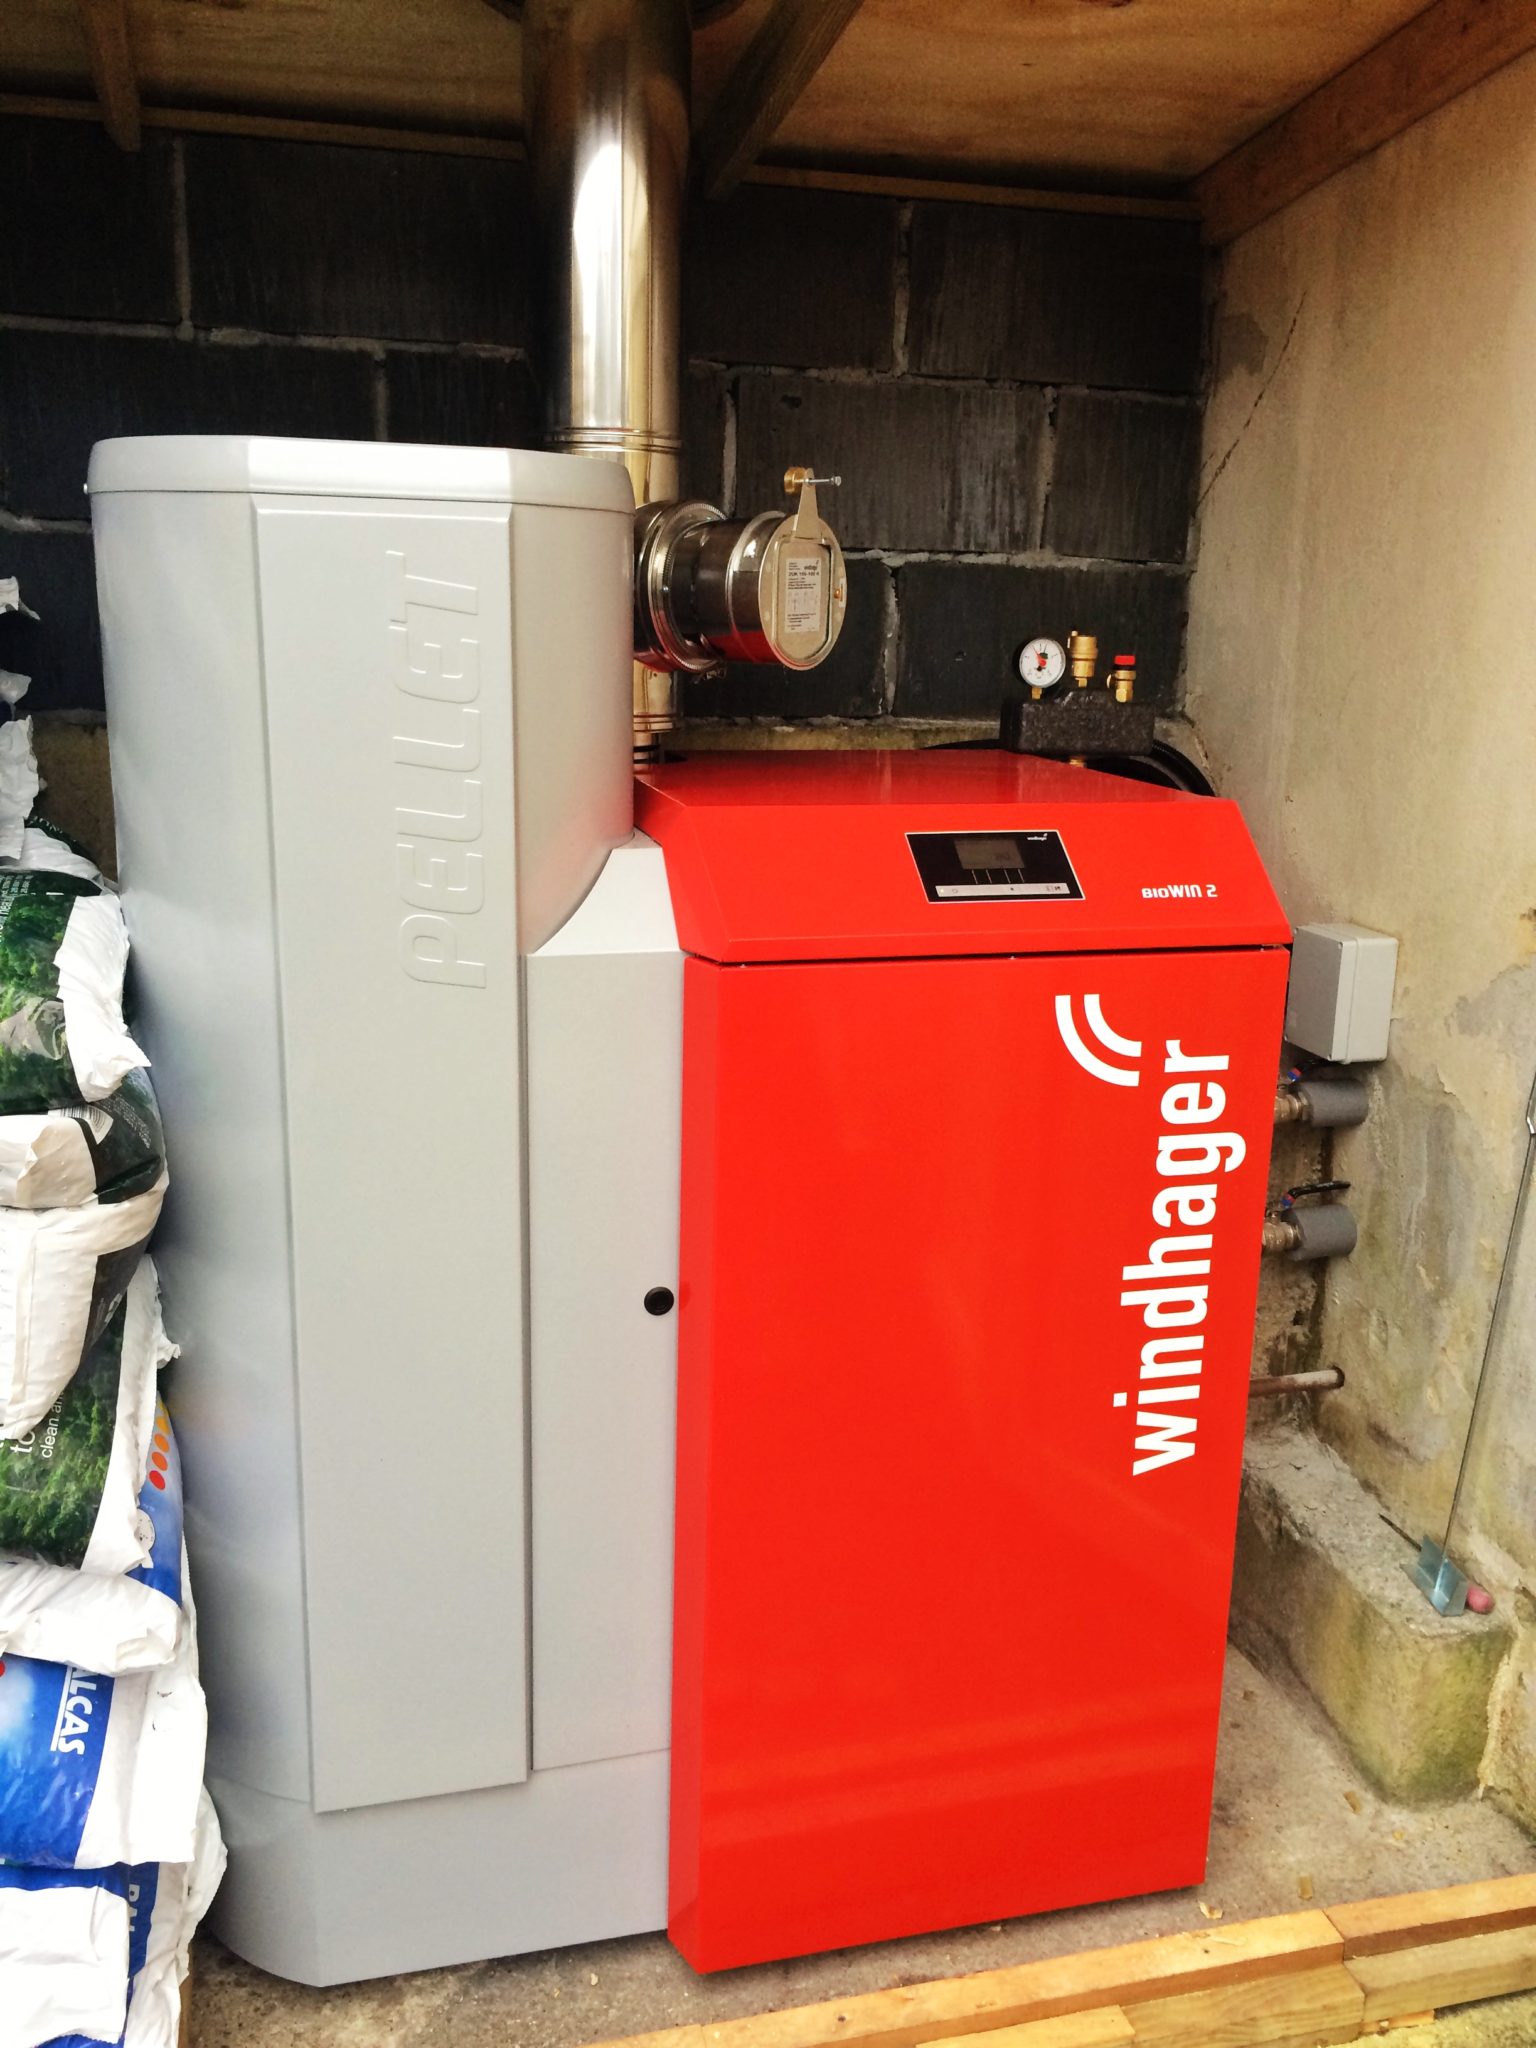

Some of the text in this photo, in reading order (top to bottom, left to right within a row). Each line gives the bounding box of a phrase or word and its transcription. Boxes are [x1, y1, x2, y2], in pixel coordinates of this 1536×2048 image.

[386, 550, 487, 989] PELLET
[1205, 884, 1219, 898] 2
[1112, 1039, 1247, 1477] windhager
[40, 1417, 60, 1459] clean
